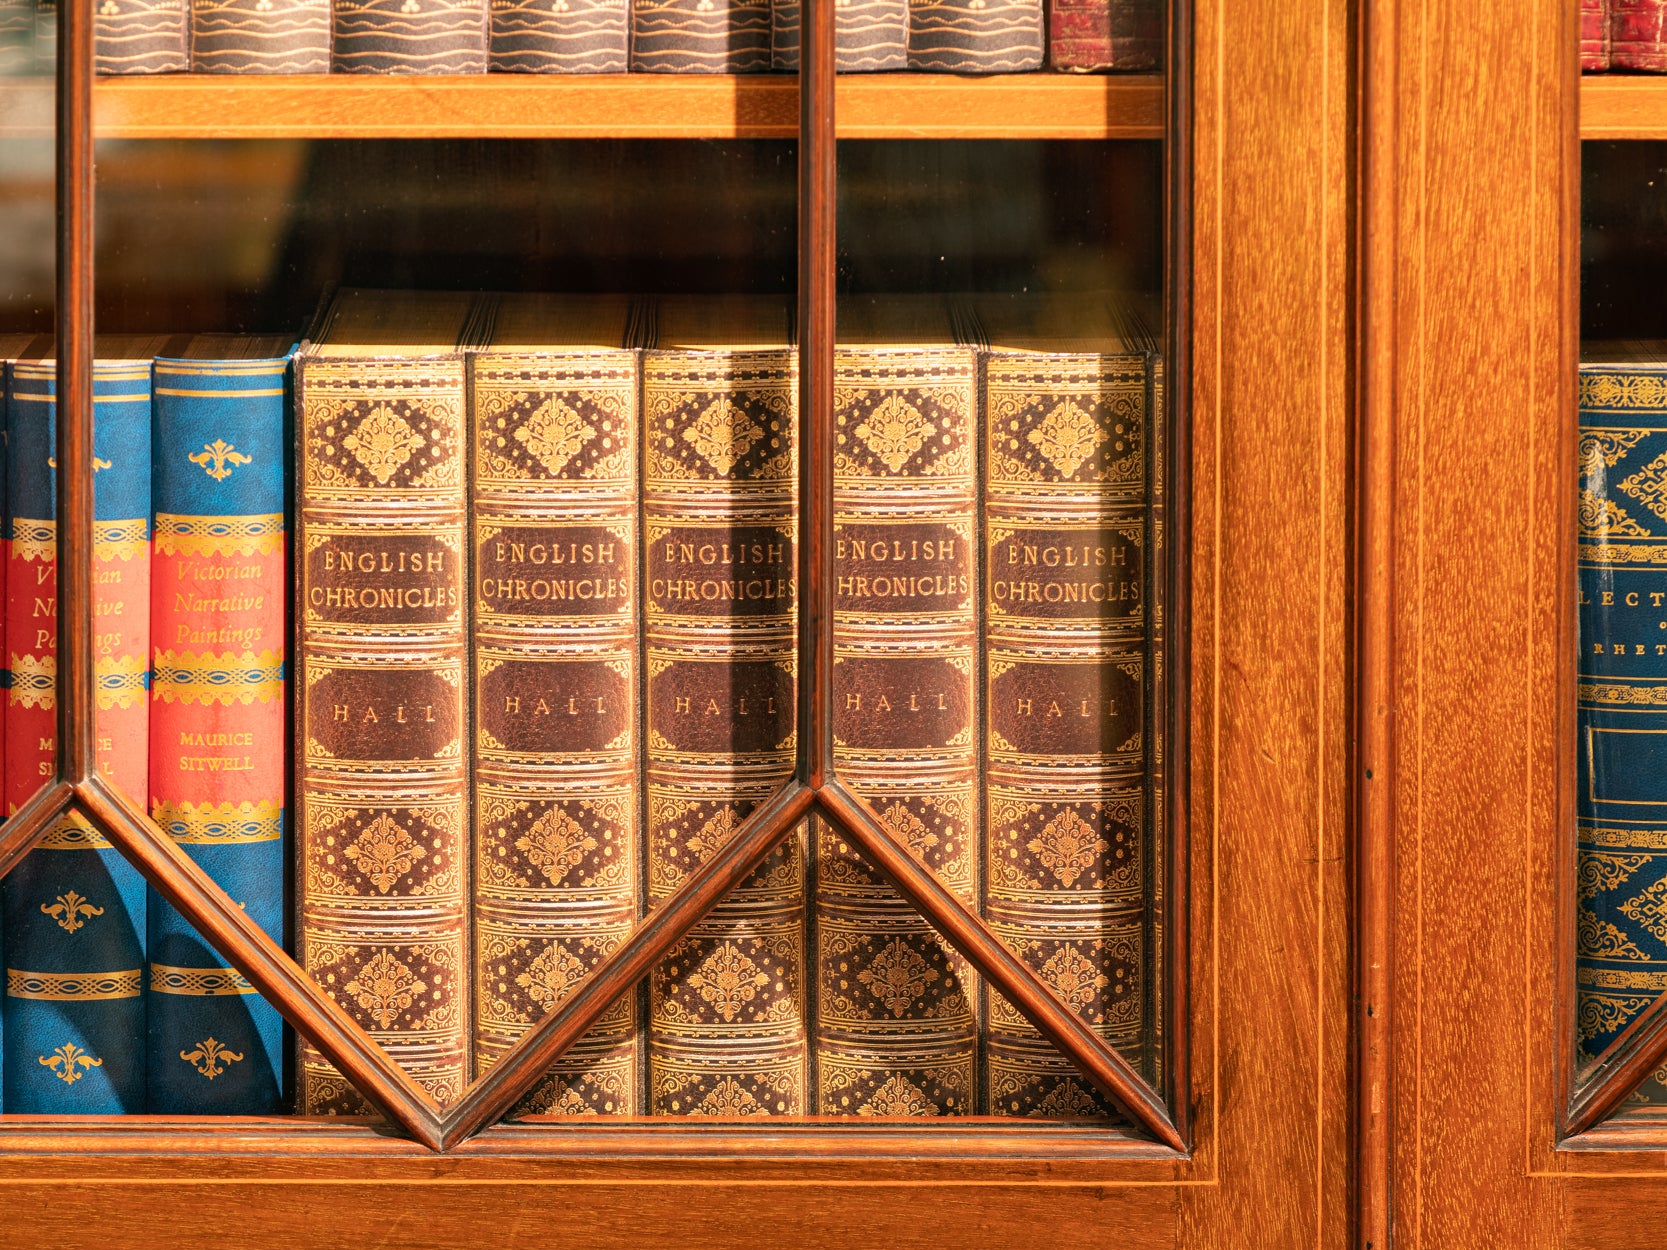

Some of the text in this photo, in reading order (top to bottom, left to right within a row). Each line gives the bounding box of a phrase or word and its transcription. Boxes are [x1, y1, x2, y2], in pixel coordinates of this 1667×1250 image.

[495, 542, 615, 565] ENGLISH
[664, 542, 784, 565] ENGLISH
[836, 540, 956, 561] ENGLISH
[1008, 545, 1127, 567] ENGLISH
[177, 561, 262, 581] Victorian
[324, 551, 445, 573] ENGLISH
[482, 578, 629, 600] CHRONICLES
[652, 578, 797, 600] CHRONICLES
[837, 575, 968, 598] HRONICLES
[994, 581, 1140, 603] CHRONICLES
[173, 591, 264, 612] Narrative
[310, 586, 457, 609] CHRONICLES
[176, 624, 262, 650] Paintings
[1593, 642, 1667, 656] RHET
[505, 696, 607, 715] HALL
[675, 696, 777, 715] HALL
[846, 693, 948, 712] HALL
[1017, 698, 1119, 717] HALL
[333, 704, 436, 723] HALL
[180, 732, 254, 747] MAURICE
[179, 756, 255, 772] SITWELL
